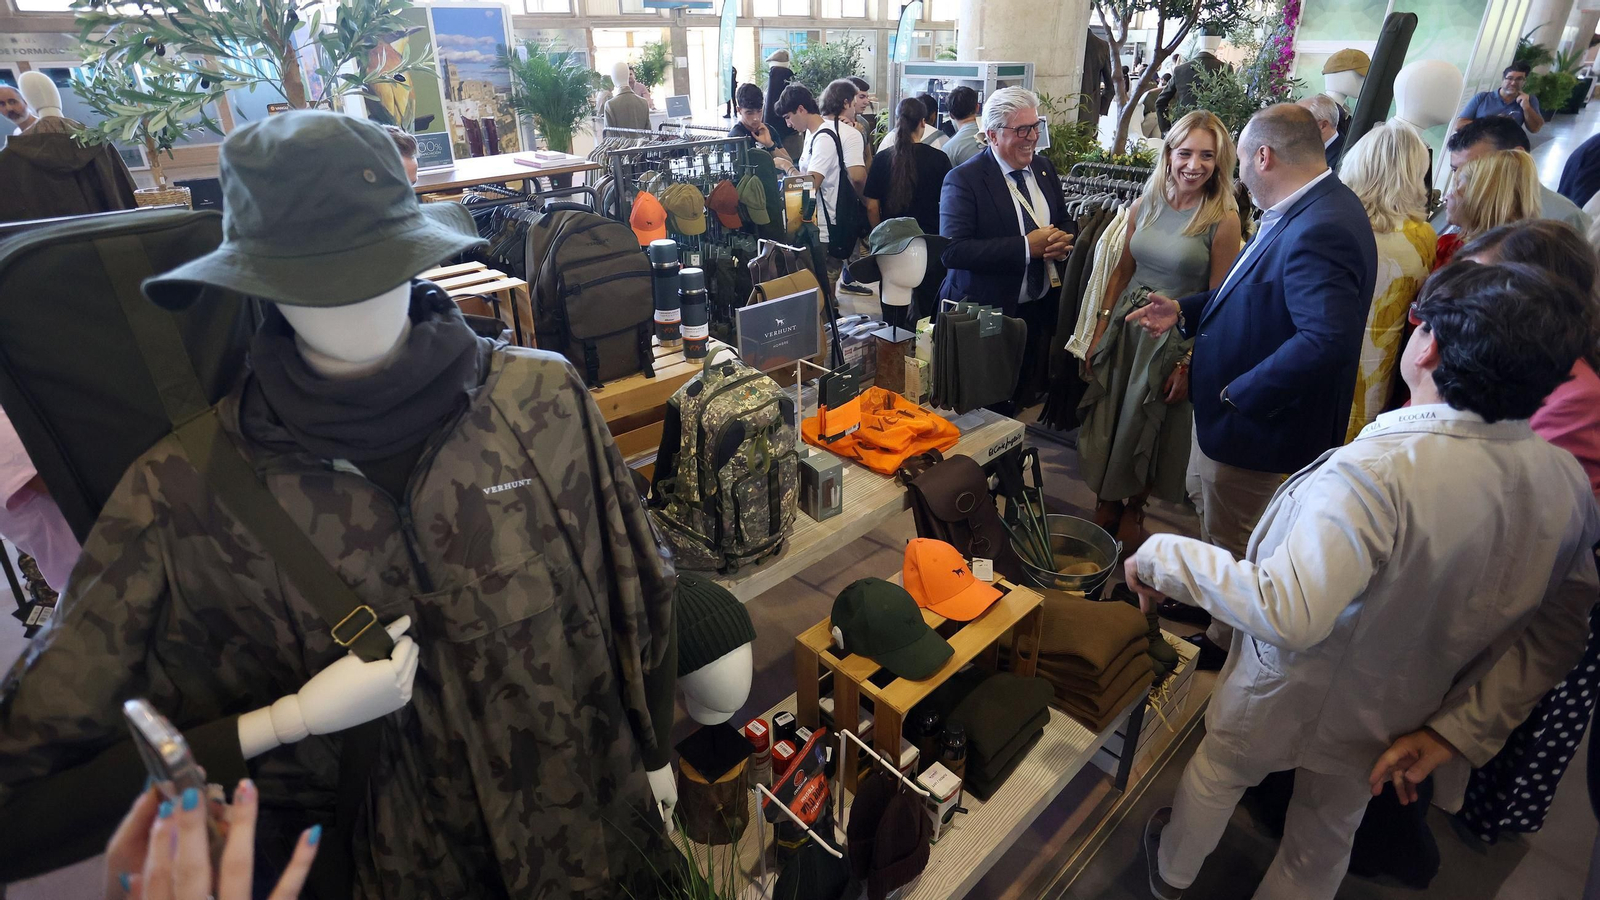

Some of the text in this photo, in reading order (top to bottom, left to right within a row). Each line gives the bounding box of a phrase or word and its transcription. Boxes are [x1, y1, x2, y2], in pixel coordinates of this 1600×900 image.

[764, 324, 798, 338] VERHUNT
[1398, 411, 1437, 422] ECOCAZA
[482, 478, 532, 495] VERHUNT
